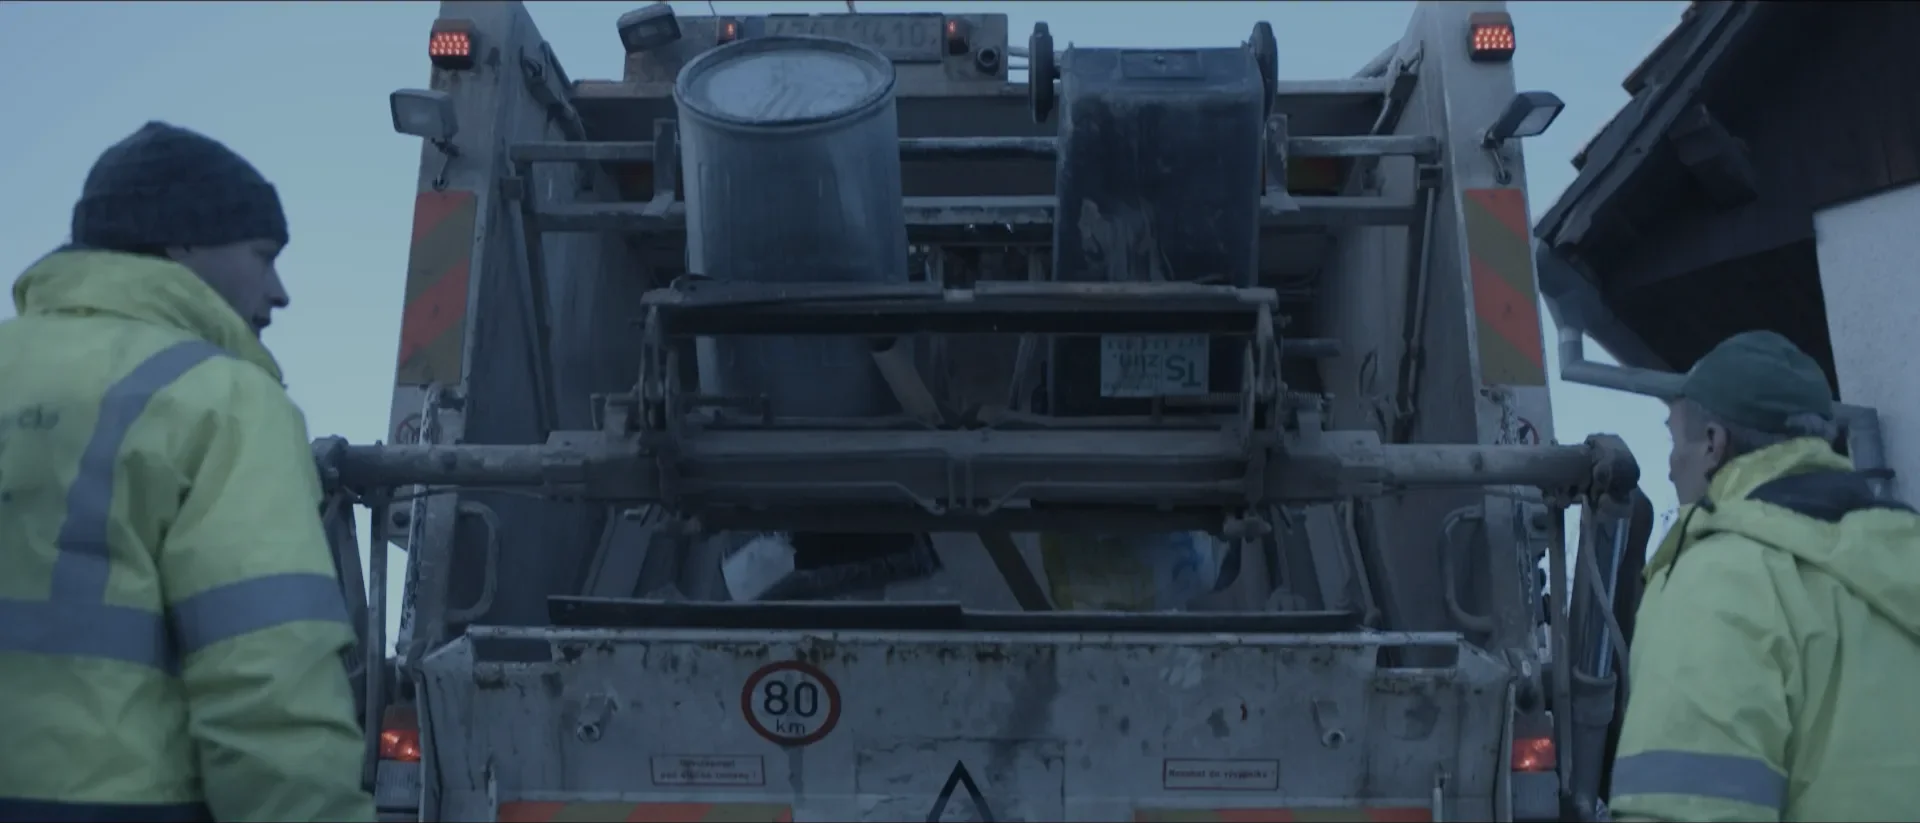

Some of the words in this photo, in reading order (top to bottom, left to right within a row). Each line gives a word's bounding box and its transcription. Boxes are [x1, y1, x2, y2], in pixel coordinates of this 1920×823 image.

[1164, 353, 1203, 389] TS
[764, 679, 819, 718] 80
[775, 717, 806, 737] km
